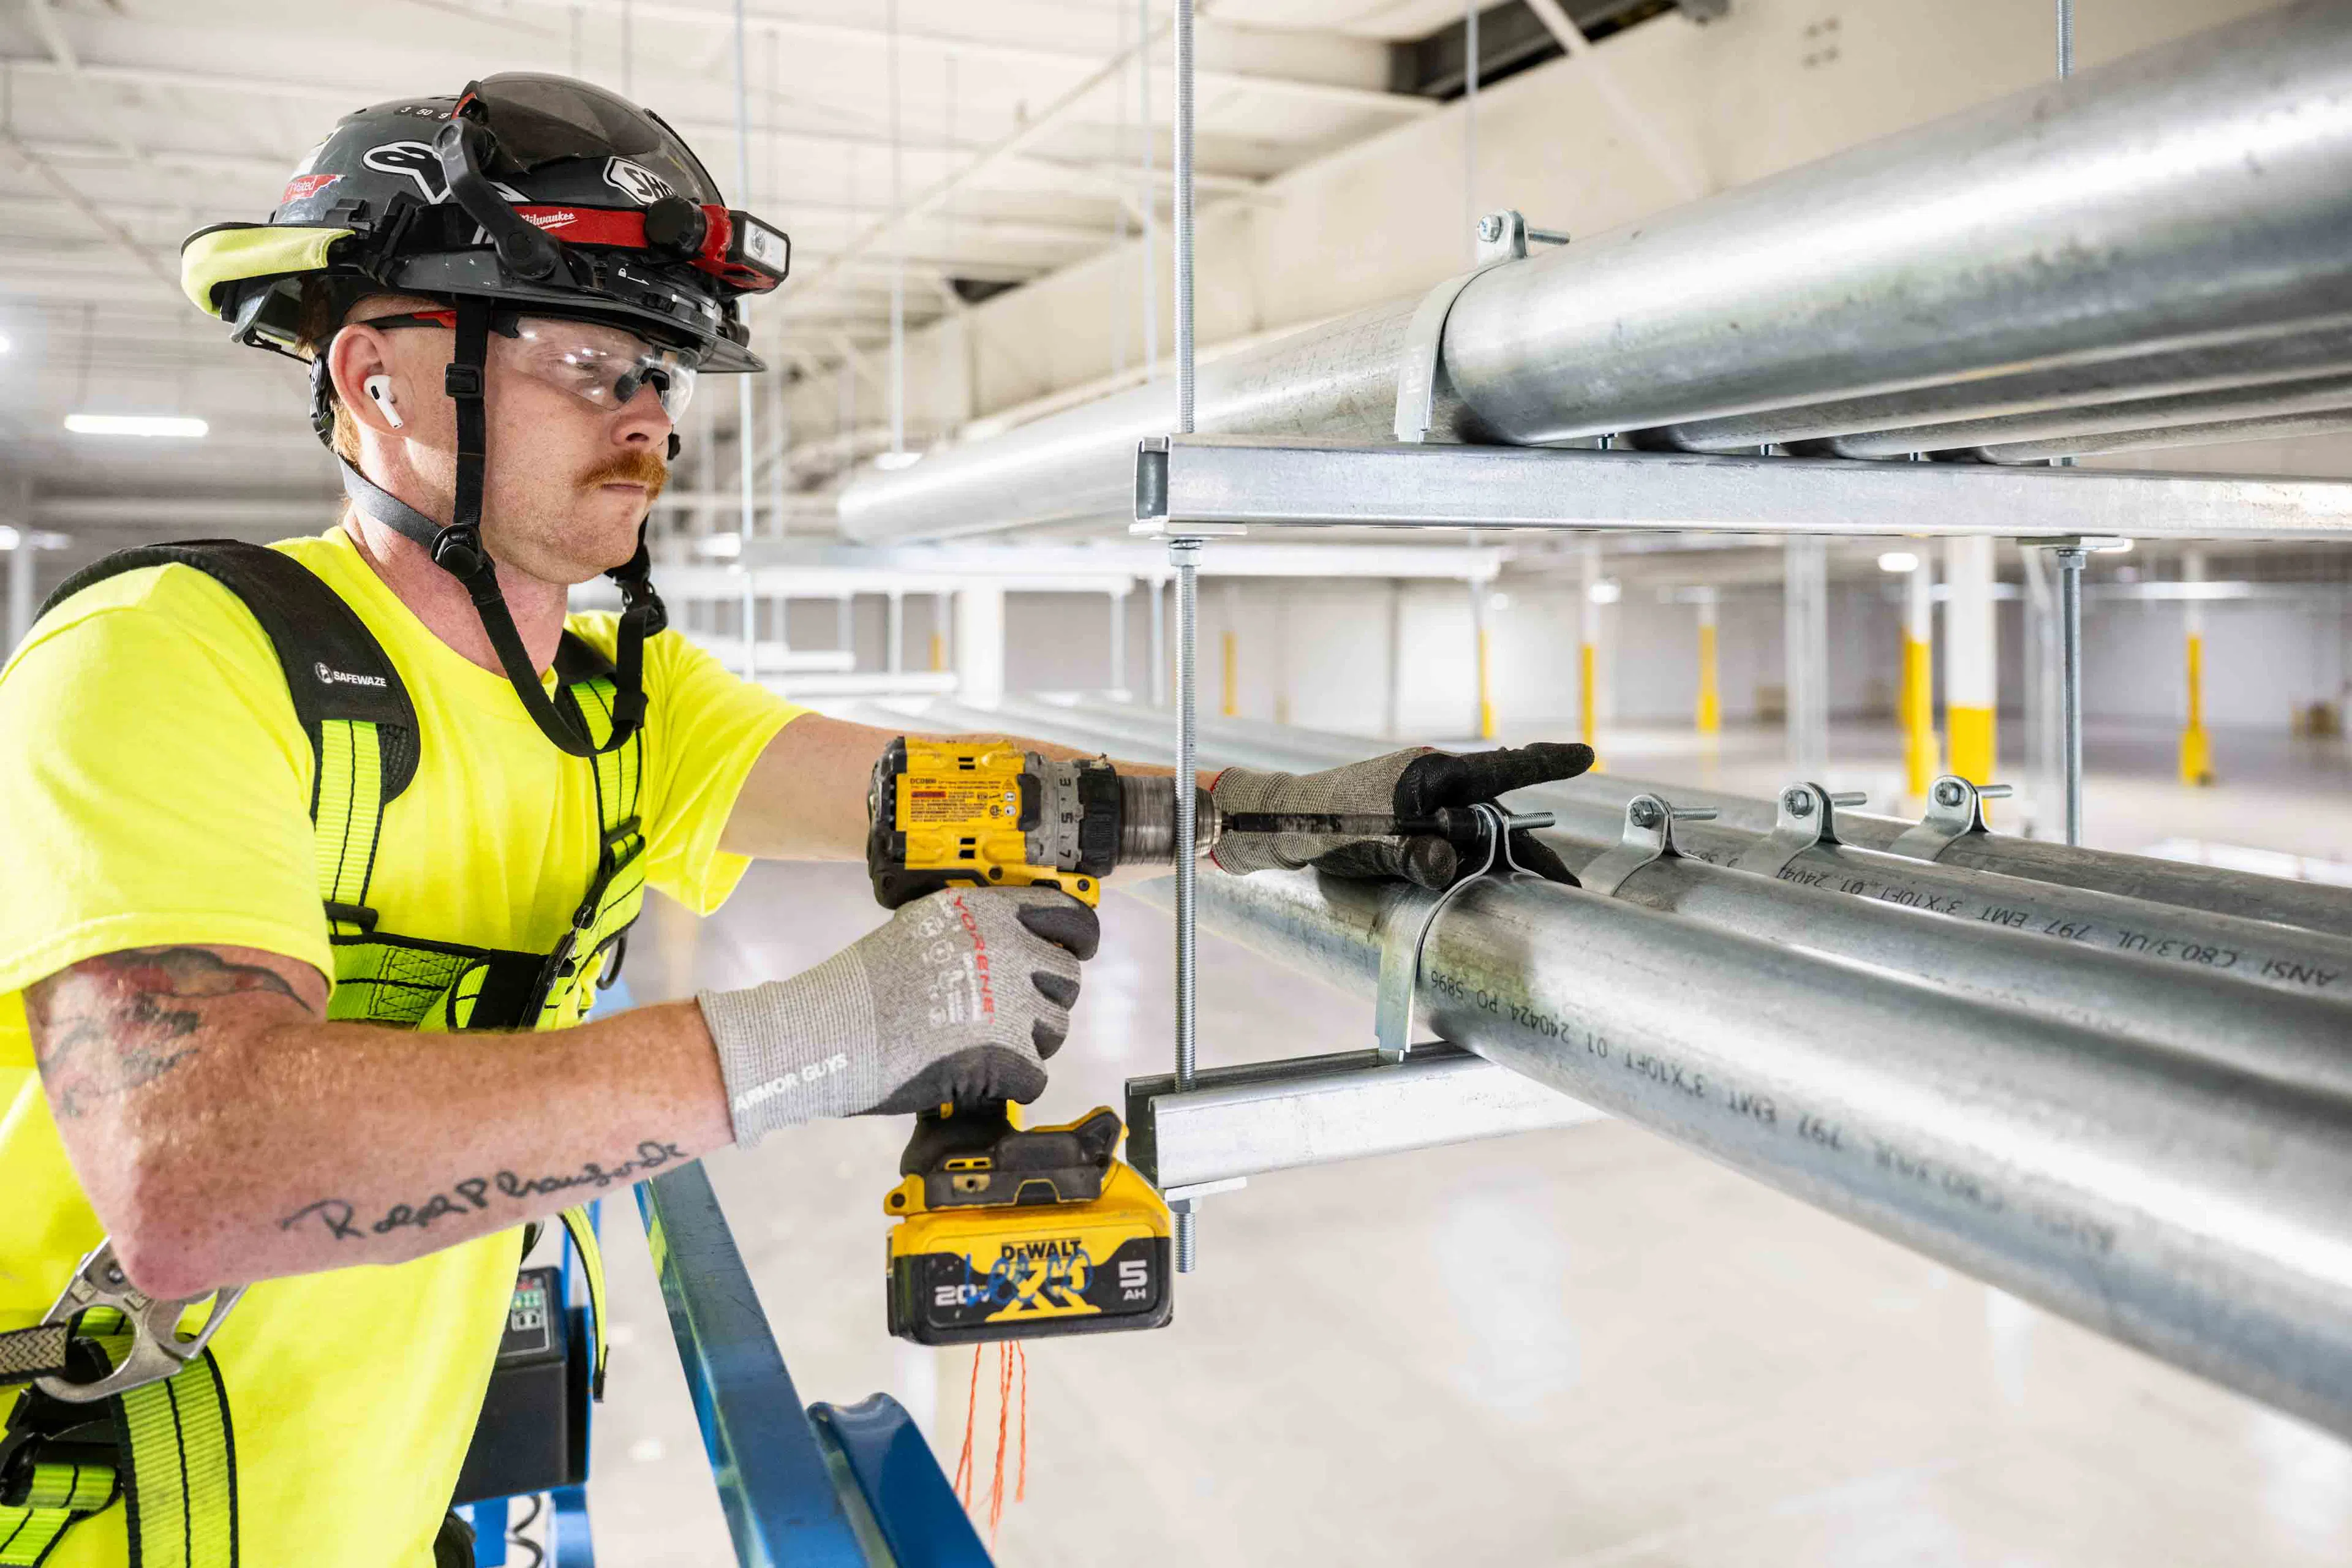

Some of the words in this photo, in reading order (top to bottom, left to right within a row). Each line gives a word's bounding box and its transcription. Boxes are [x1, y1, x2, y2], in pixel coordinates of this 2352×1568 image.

[333, 671, 386, 687] SAFEWAZE
[1977, 905, 2028, 929] EMT
[2043, 919, 2092, 942] 797
[1430, 970, 1464, 998] 5896
[2261, 959, 2337, 987] ANSI
[1476, 989, 1499, 1014] PO
[1509, 1002, 1570, 1043] 240424
[1587, 1031, 1609, 1058] 01
[735, 1074, 797, 1112] ARMOR
[801, 1052, 850, 1085] GUYS
[1118, 1259, 1148, 1289] 5
[1123, 1287, 1147, 1302] AH
